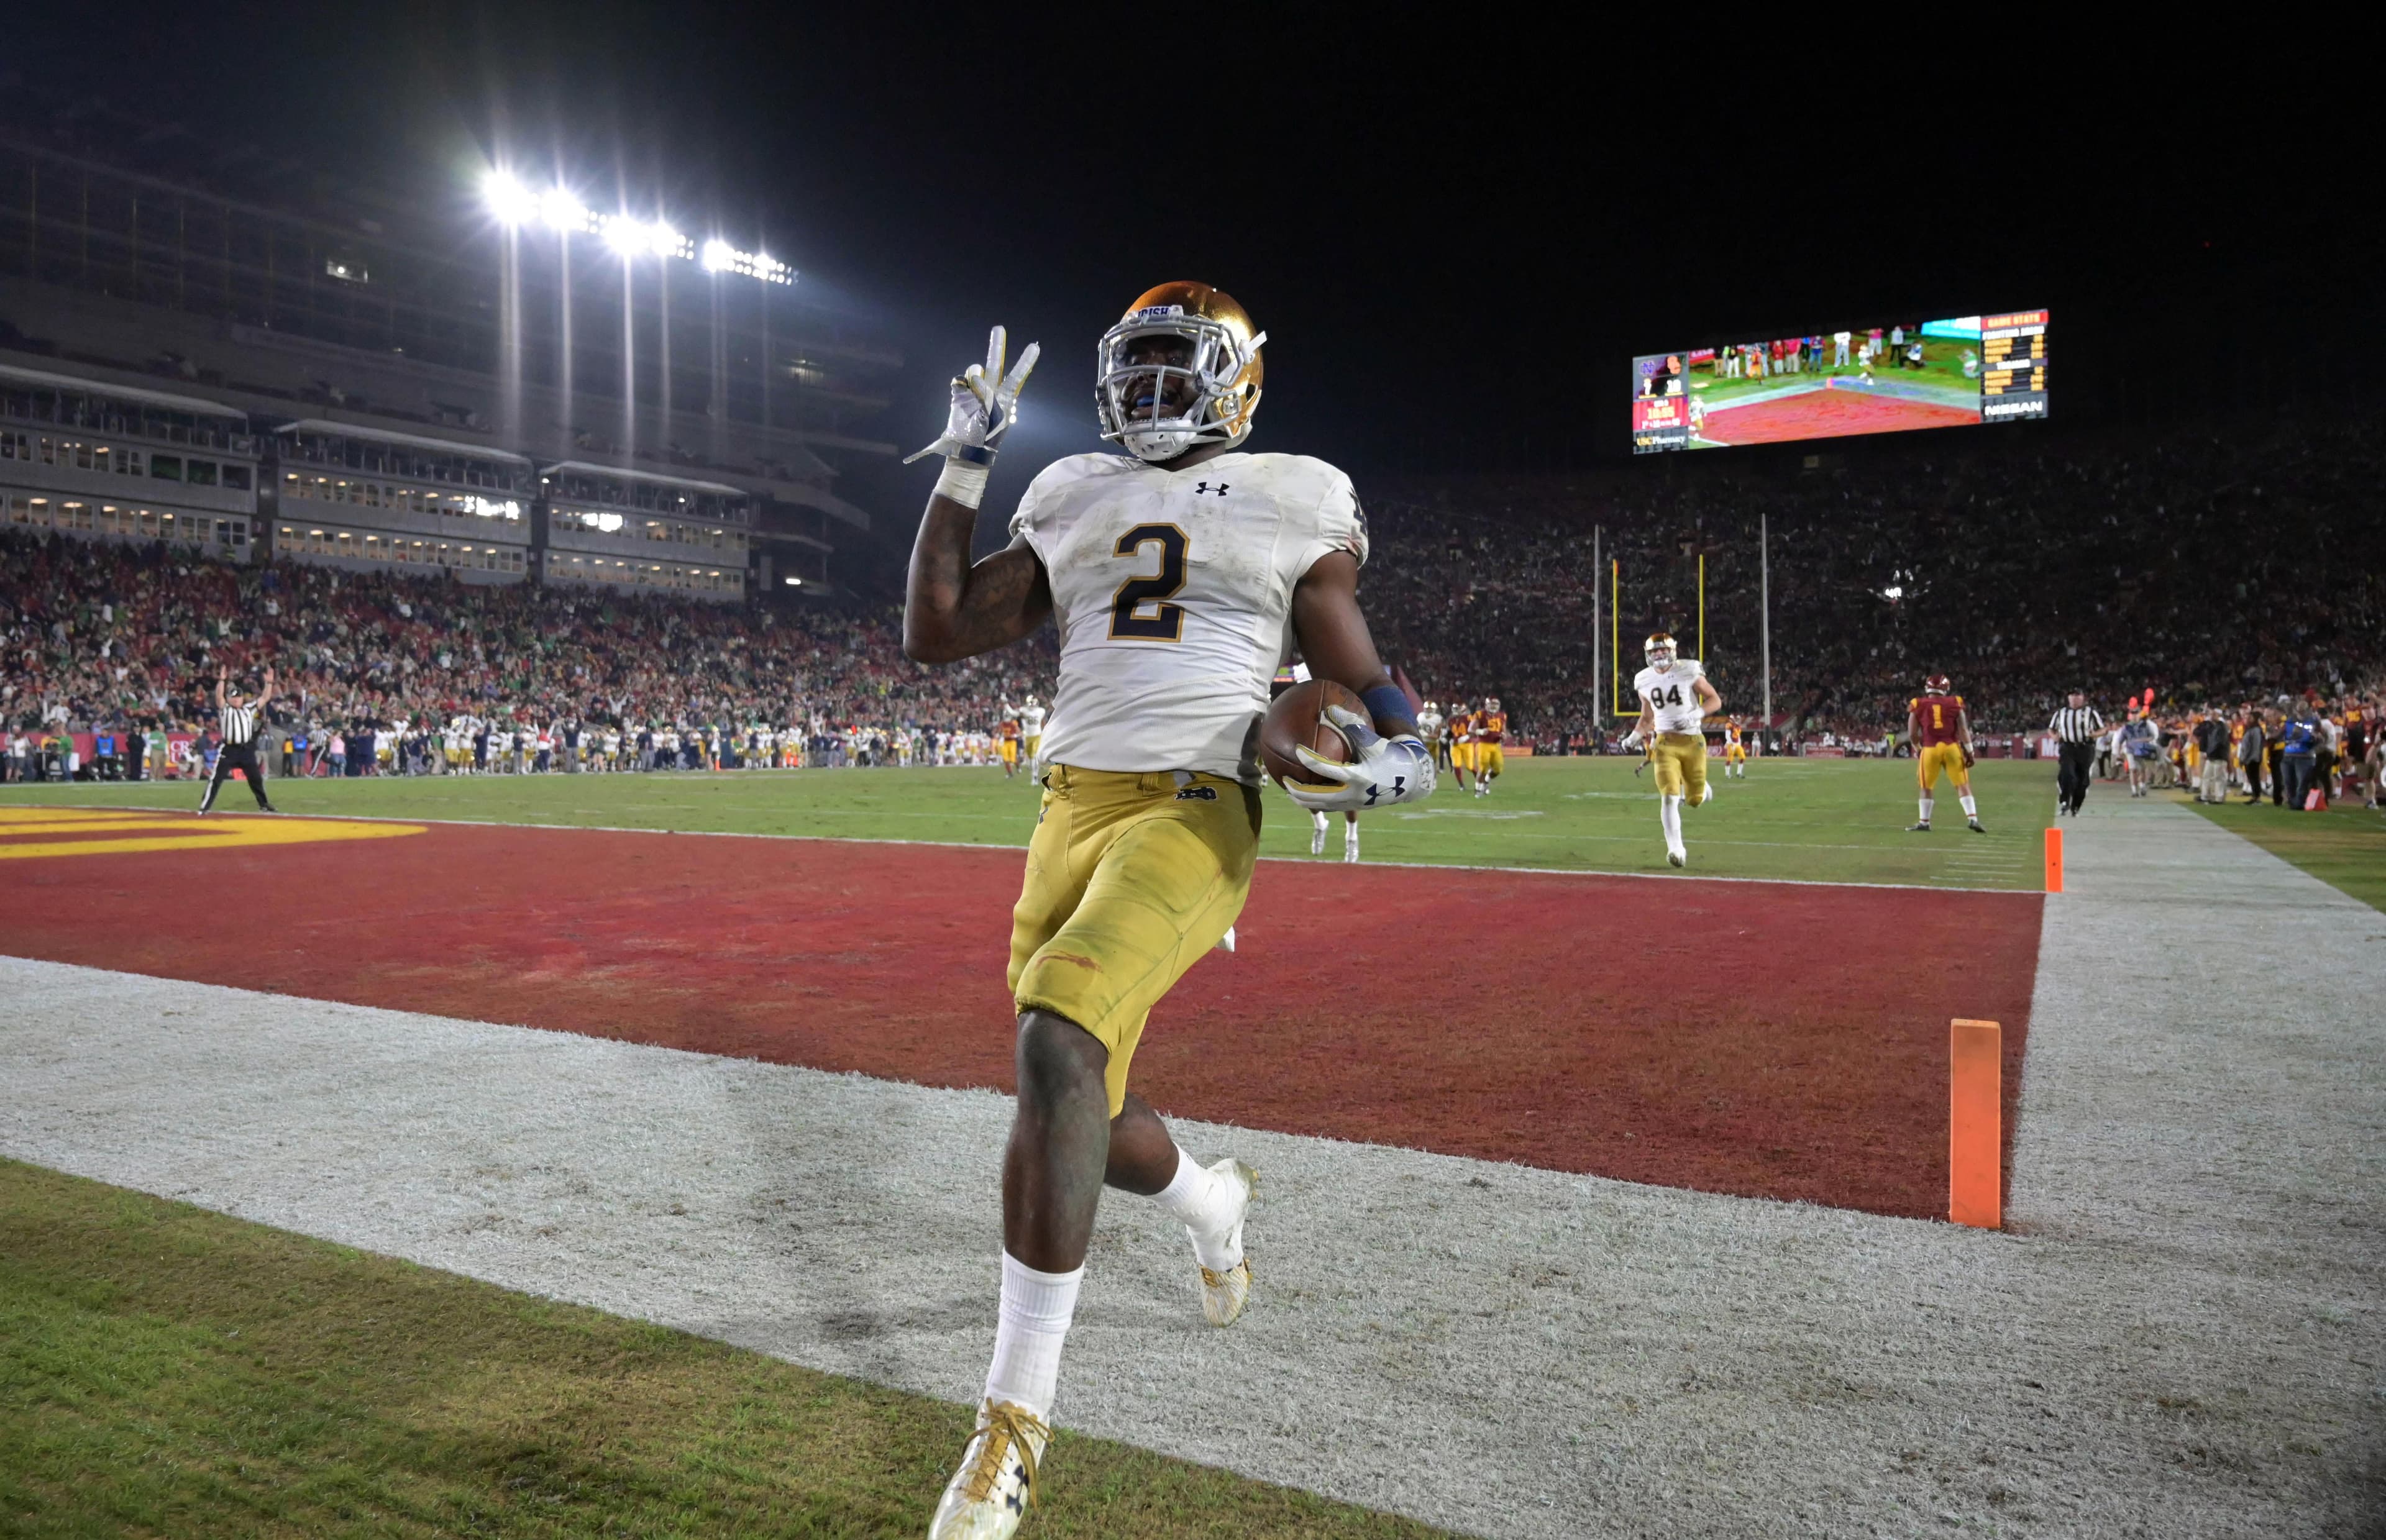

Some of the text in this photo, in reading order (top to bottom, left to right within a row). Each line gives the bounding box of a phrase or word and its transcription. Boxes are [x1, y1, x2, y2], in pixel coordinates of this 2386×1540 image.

[1138, 308, 1169, 317] IRISH
[1985, 401, 2043, 416] NISSAN
[1652, 435, 1686, 445] Pharmacy
[1107, 522, 1190, 643] 2
[1651, 684, 1683, 709] 84
[1932, 704, 1944, 729] 1
